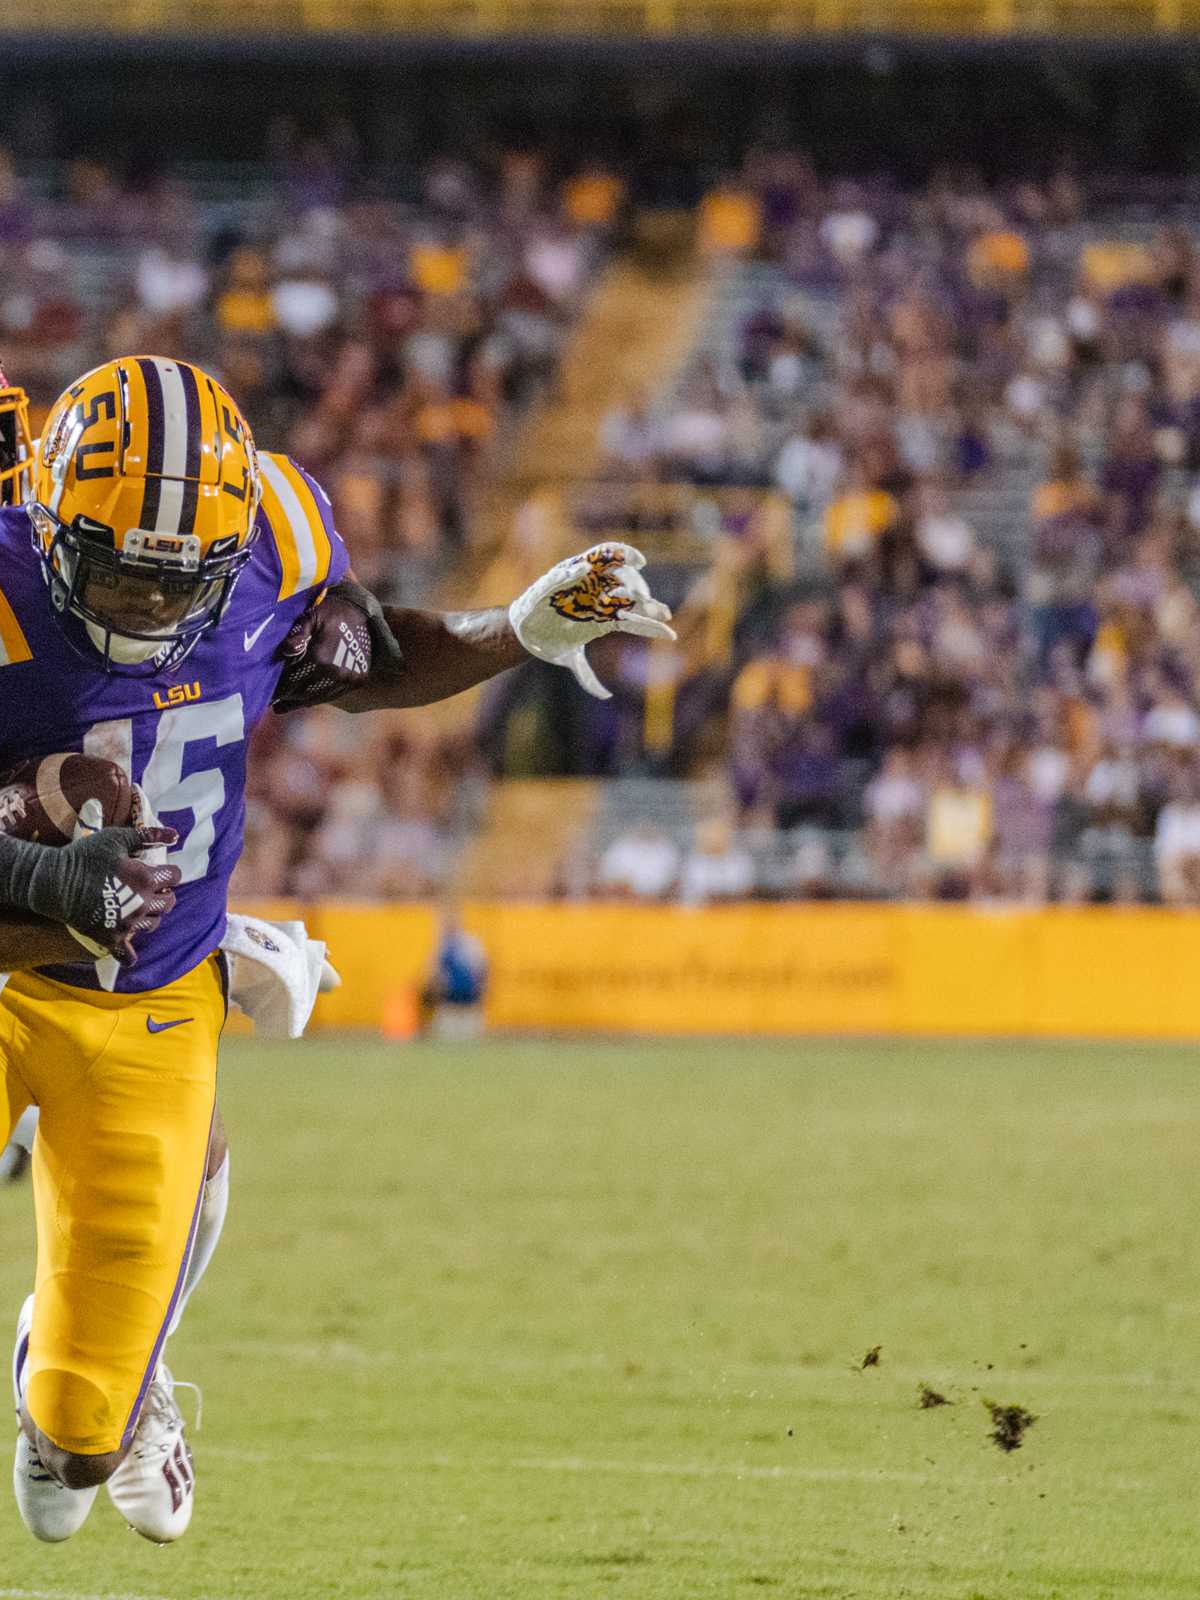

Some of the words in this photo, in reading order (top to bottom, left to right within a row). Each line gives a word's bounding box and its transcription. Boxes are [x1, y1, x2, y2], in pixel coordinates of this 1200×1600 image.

[143, 536, 184, 553] LSU
[339, 622, 368, 673] adidas
[153, 681, 202, 710] LSU
